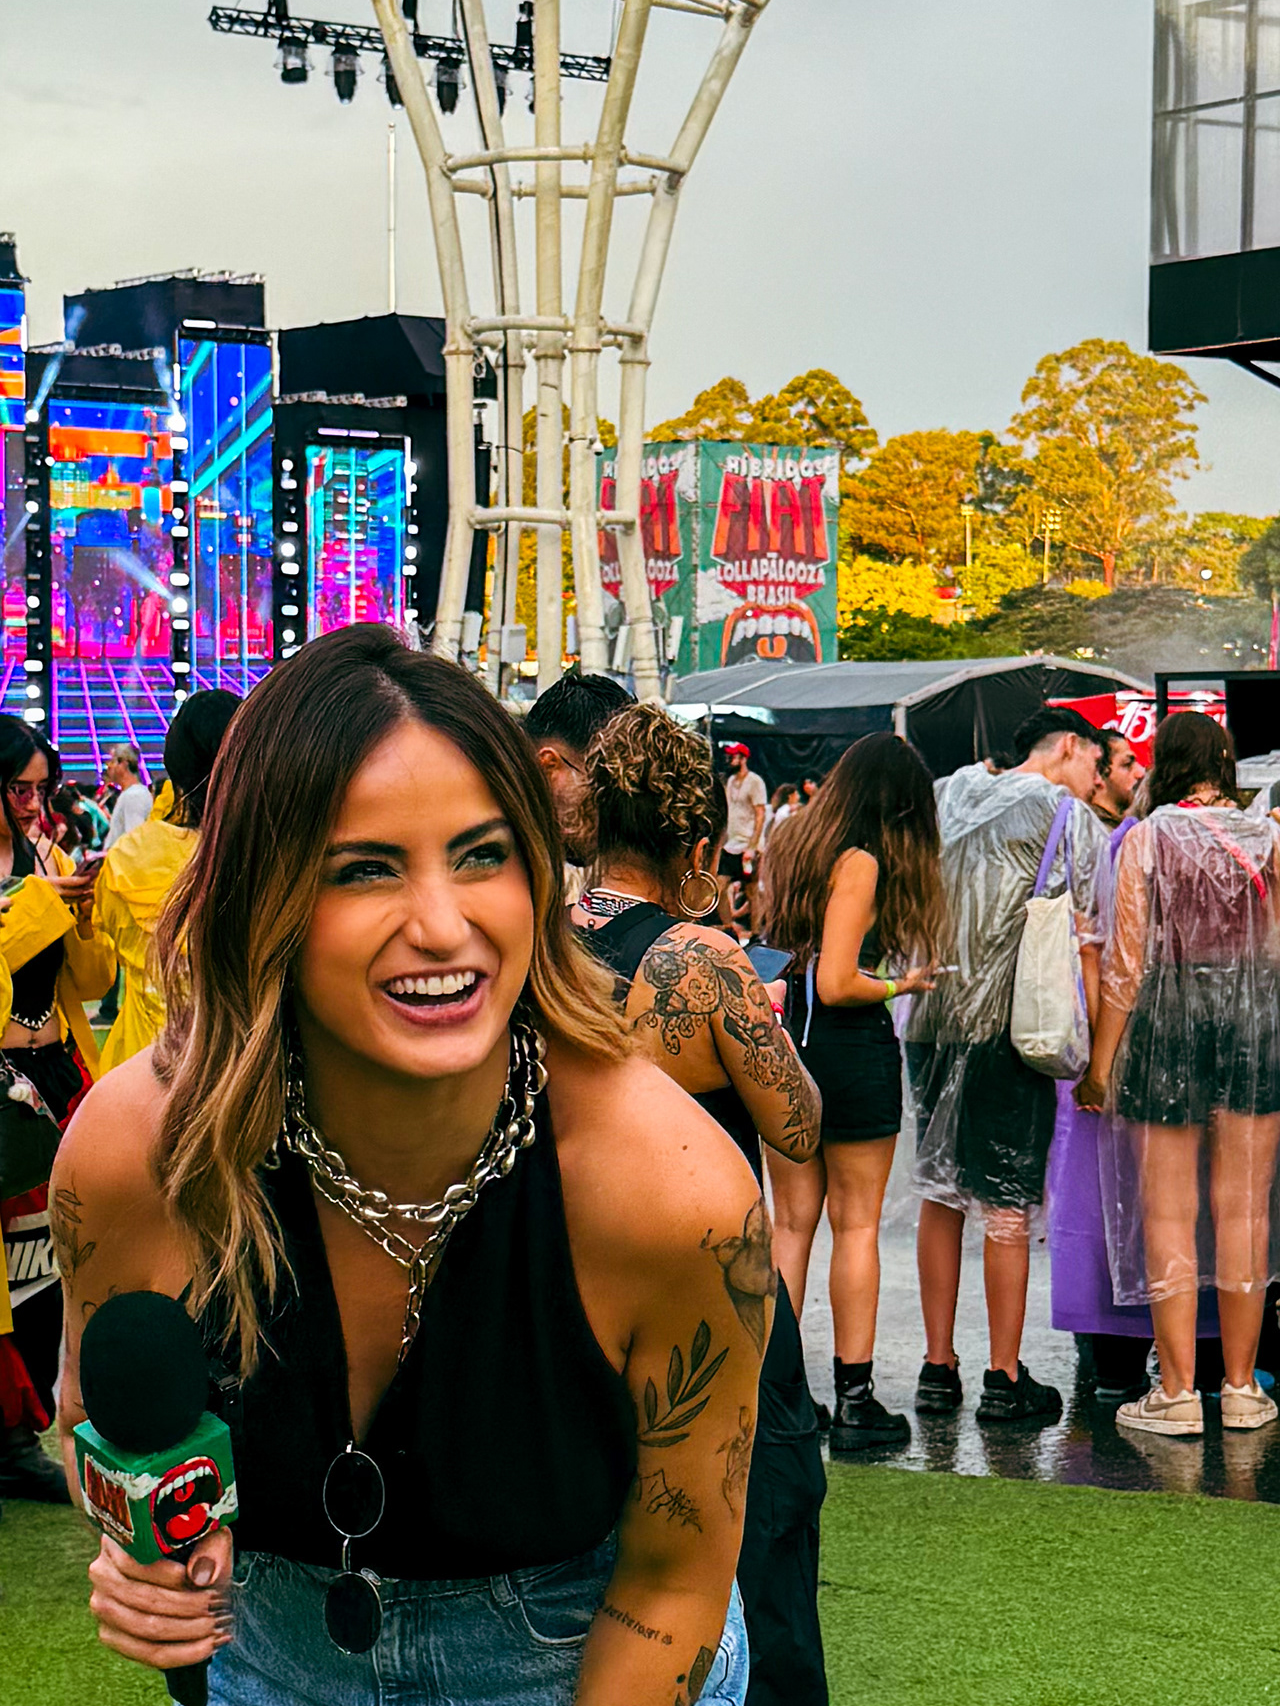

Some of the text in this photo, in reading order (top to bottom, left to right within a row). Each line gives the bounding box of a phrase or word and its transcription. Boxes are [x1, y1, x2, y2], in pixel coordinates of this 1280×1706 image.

[712, 471, 829, 560] FIAT
[746, 584, 797, 606] BRASIL
[4, 1237, 61, 1281] NIK
